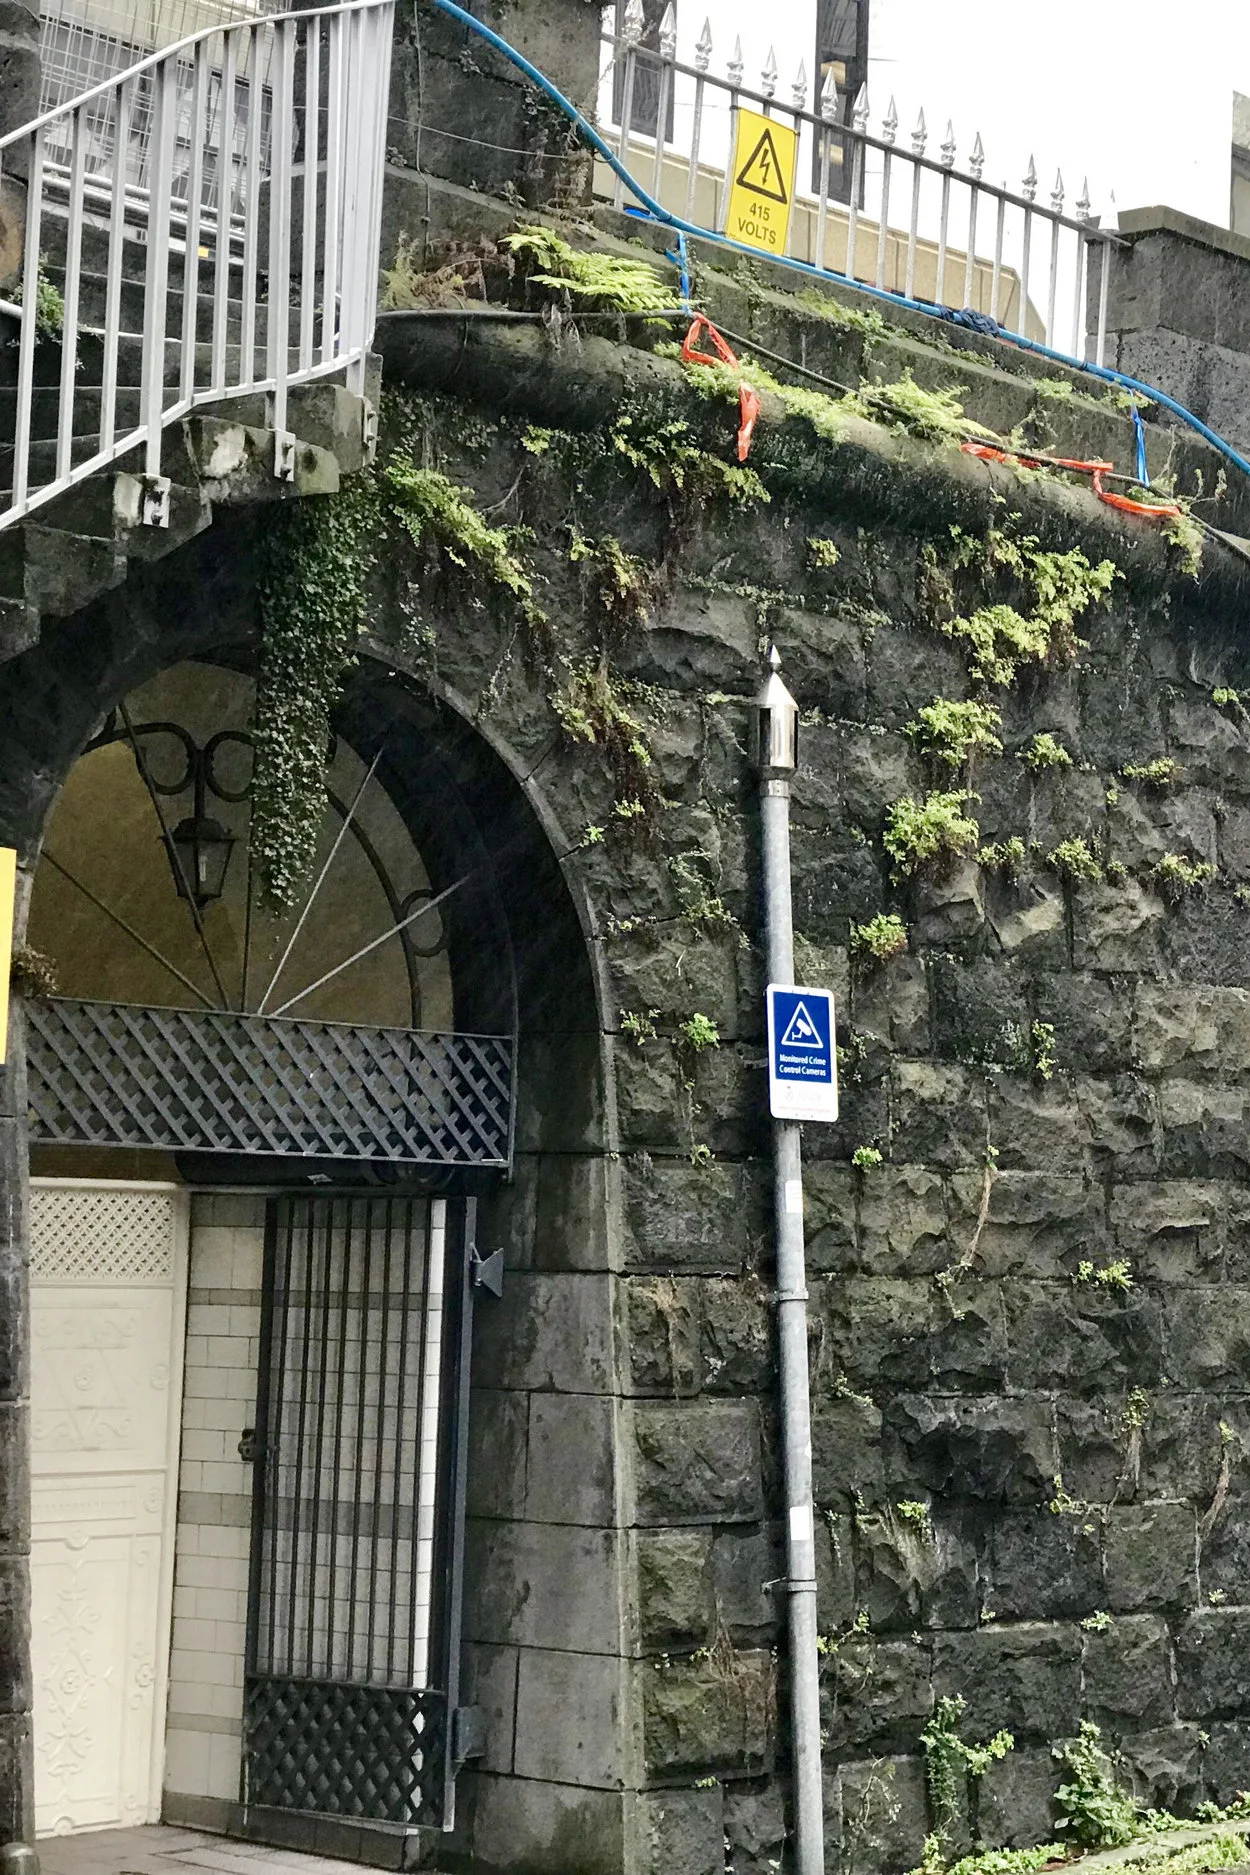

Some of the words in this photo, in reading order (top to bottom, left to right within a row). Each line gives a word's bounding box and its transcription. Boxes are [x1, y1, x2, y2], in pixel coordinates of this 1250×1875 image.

[749, 202, 771, 221] 415
[738, 217, 777, 244] VOLTS
[779, 1053, 808, 1064] Monitored
[809, 1056, 826, 1065] Crime
[779, 1064, 801, 1074] Control
[801, 1066, 826, 1077] Cameras
